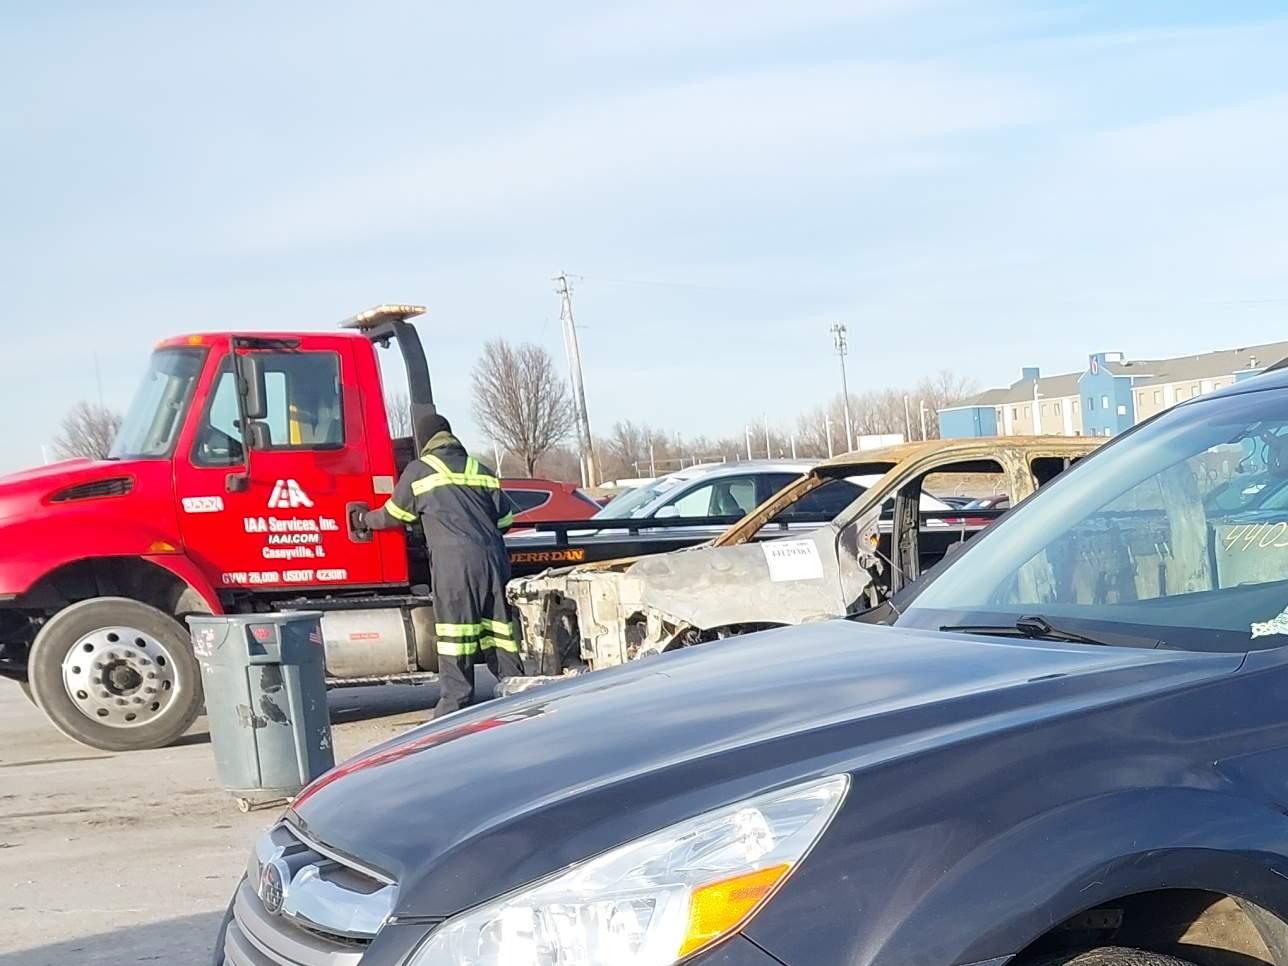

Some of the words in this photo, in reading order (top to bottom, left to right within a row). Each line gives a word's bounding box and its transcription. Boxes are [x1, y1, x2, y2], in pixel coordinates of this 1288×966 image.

[243, 517, 268, 533] IAA
[268, 516, 319, 532] Services,
[319, 515, 339, 531] Inc.
[268, 533, 320, 544] IAAI.COM
[222, 571, 247, 584] GVW
[282, 570, 314, 582] USDOT
